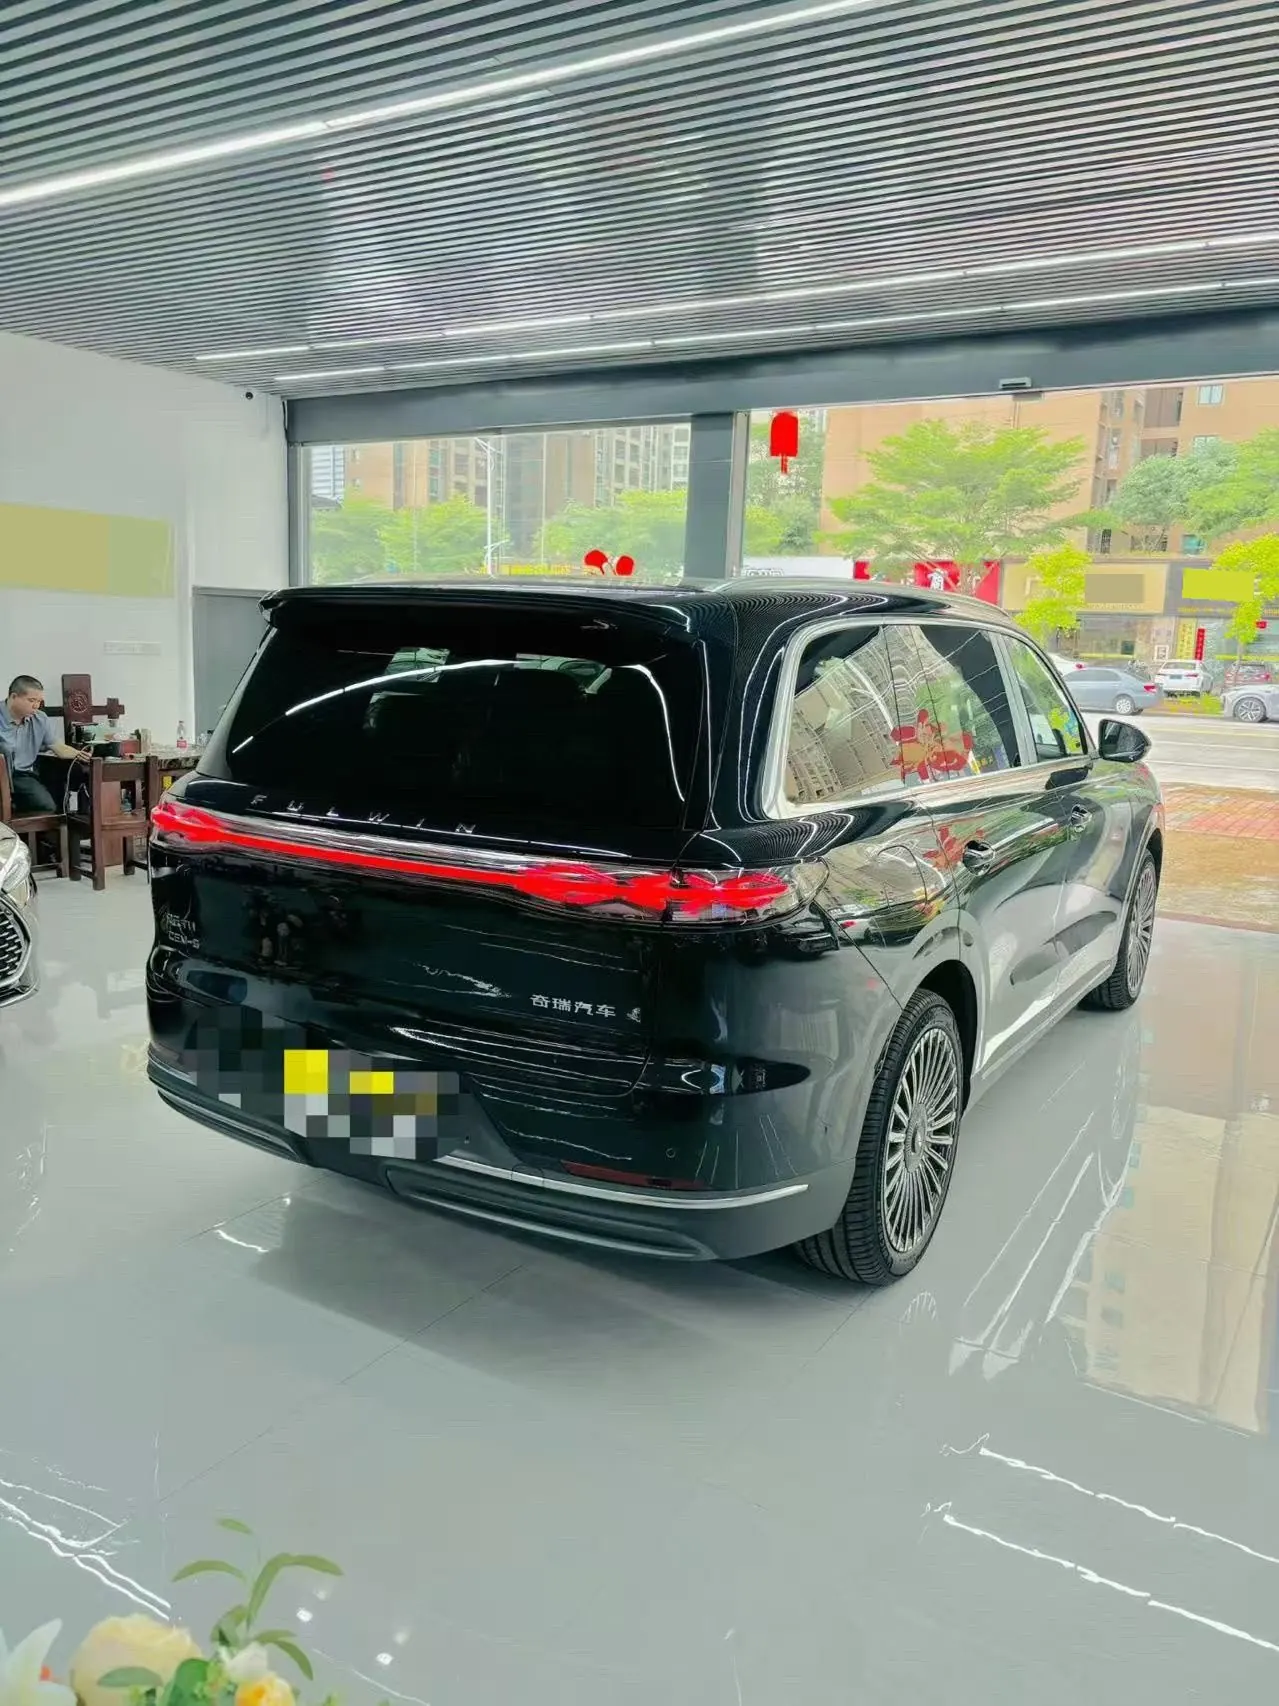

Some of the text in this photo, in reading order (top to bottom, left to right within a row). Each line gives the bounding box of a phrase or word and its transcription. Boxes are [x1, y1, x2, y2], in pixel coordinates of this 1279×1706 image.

[251, 794, 475, 834] FULWIN
[530, 994, 616, 1017] 奇瑞汽车
